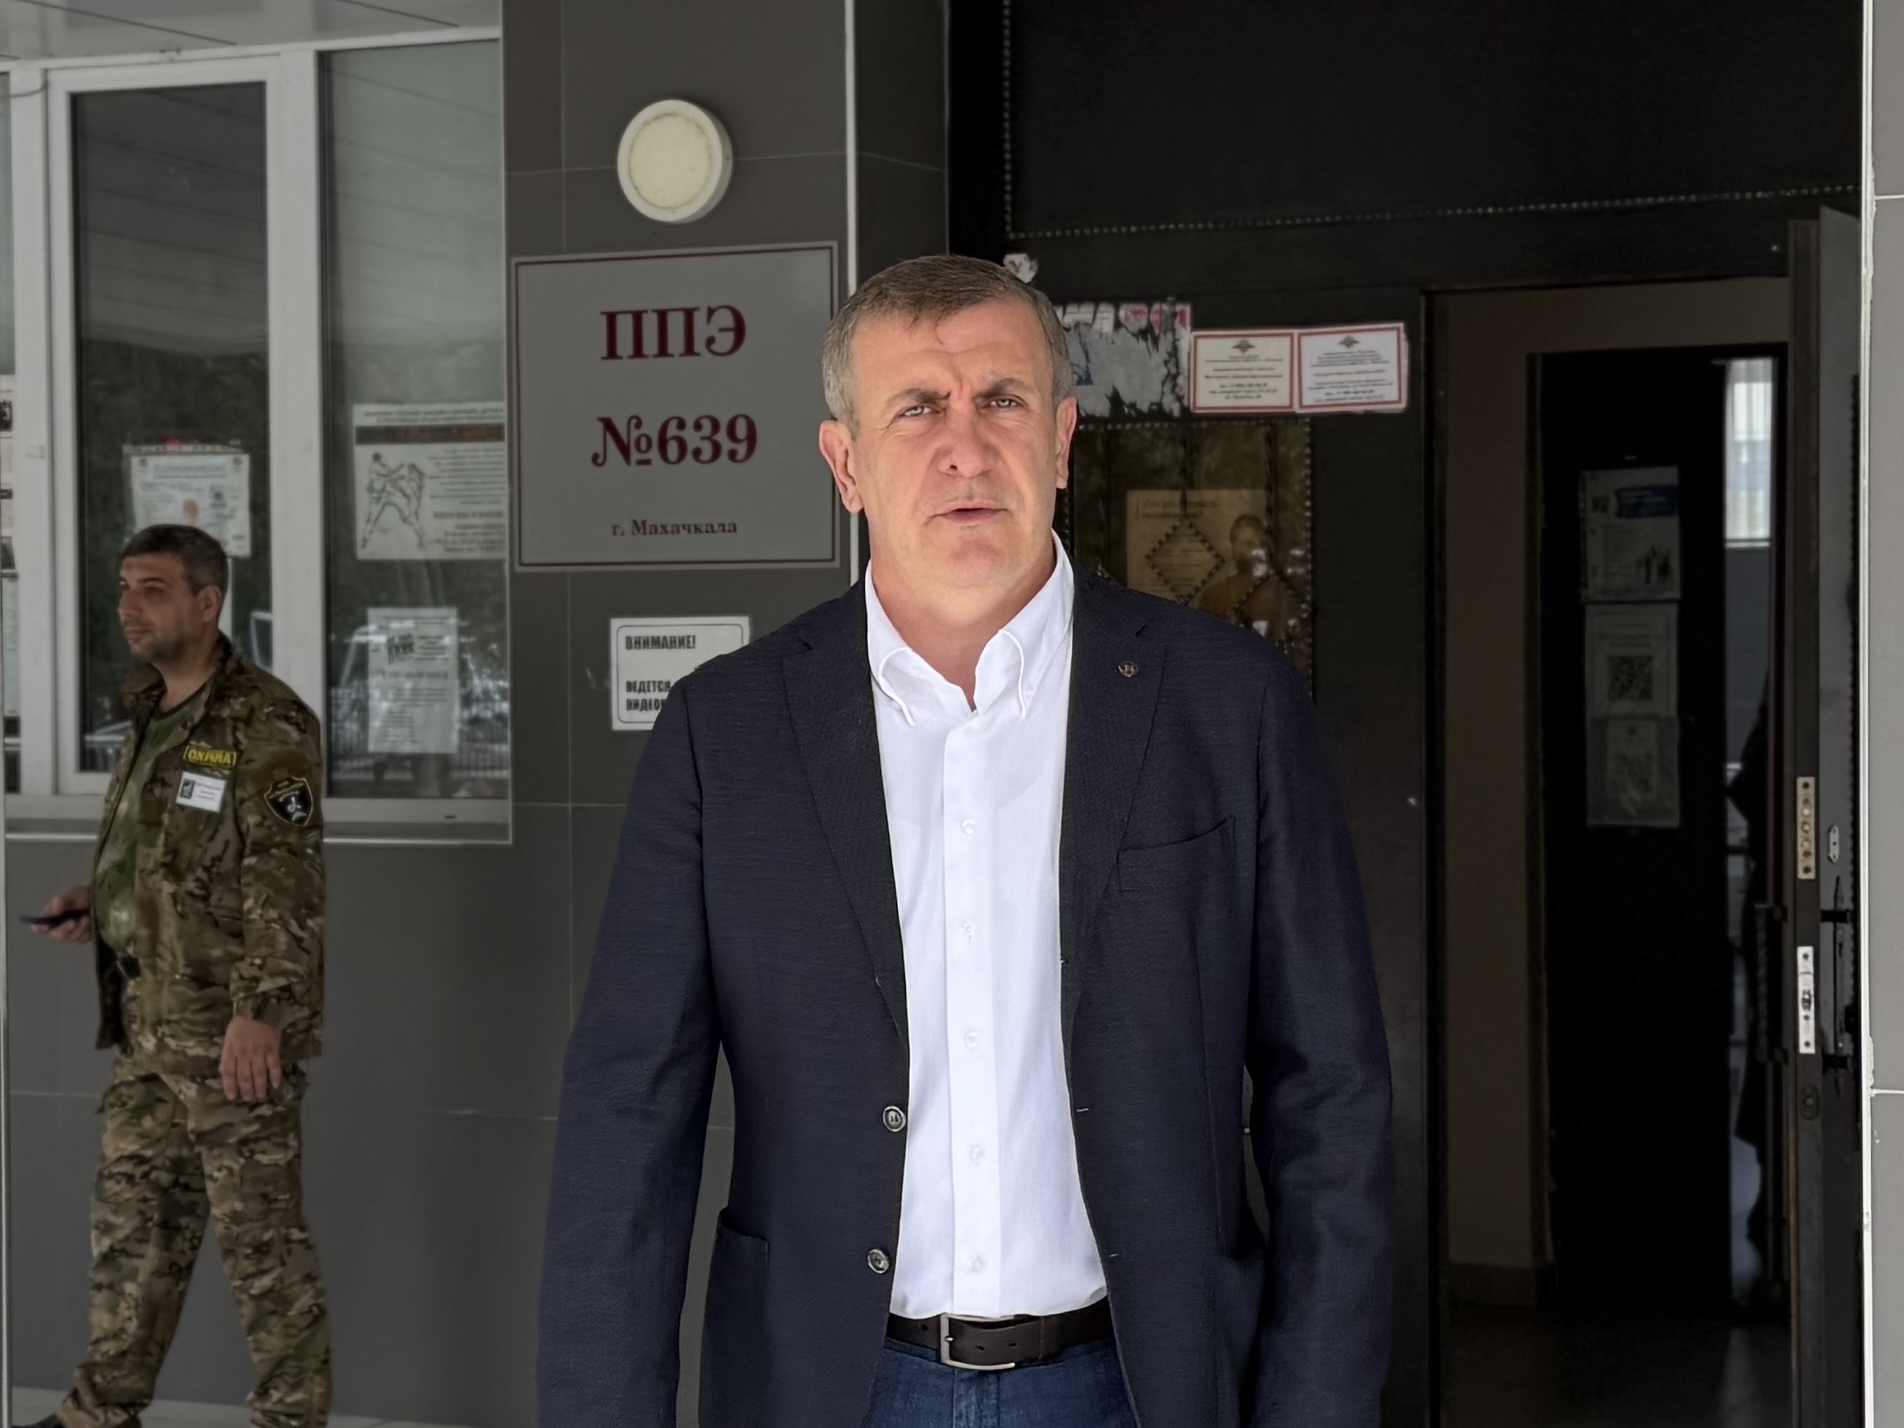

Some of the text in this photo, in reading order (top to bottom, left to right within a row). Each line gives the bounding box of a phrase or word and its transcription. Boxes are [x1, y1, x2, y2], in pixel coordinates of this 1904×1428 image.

[600, 304, 747, 361] ППЭ
[591, 413, 758, 468] №639
[631, 519, 738, 537] Махачкала
[625, 634, 696, 651] ВНИМАНИЕ!
